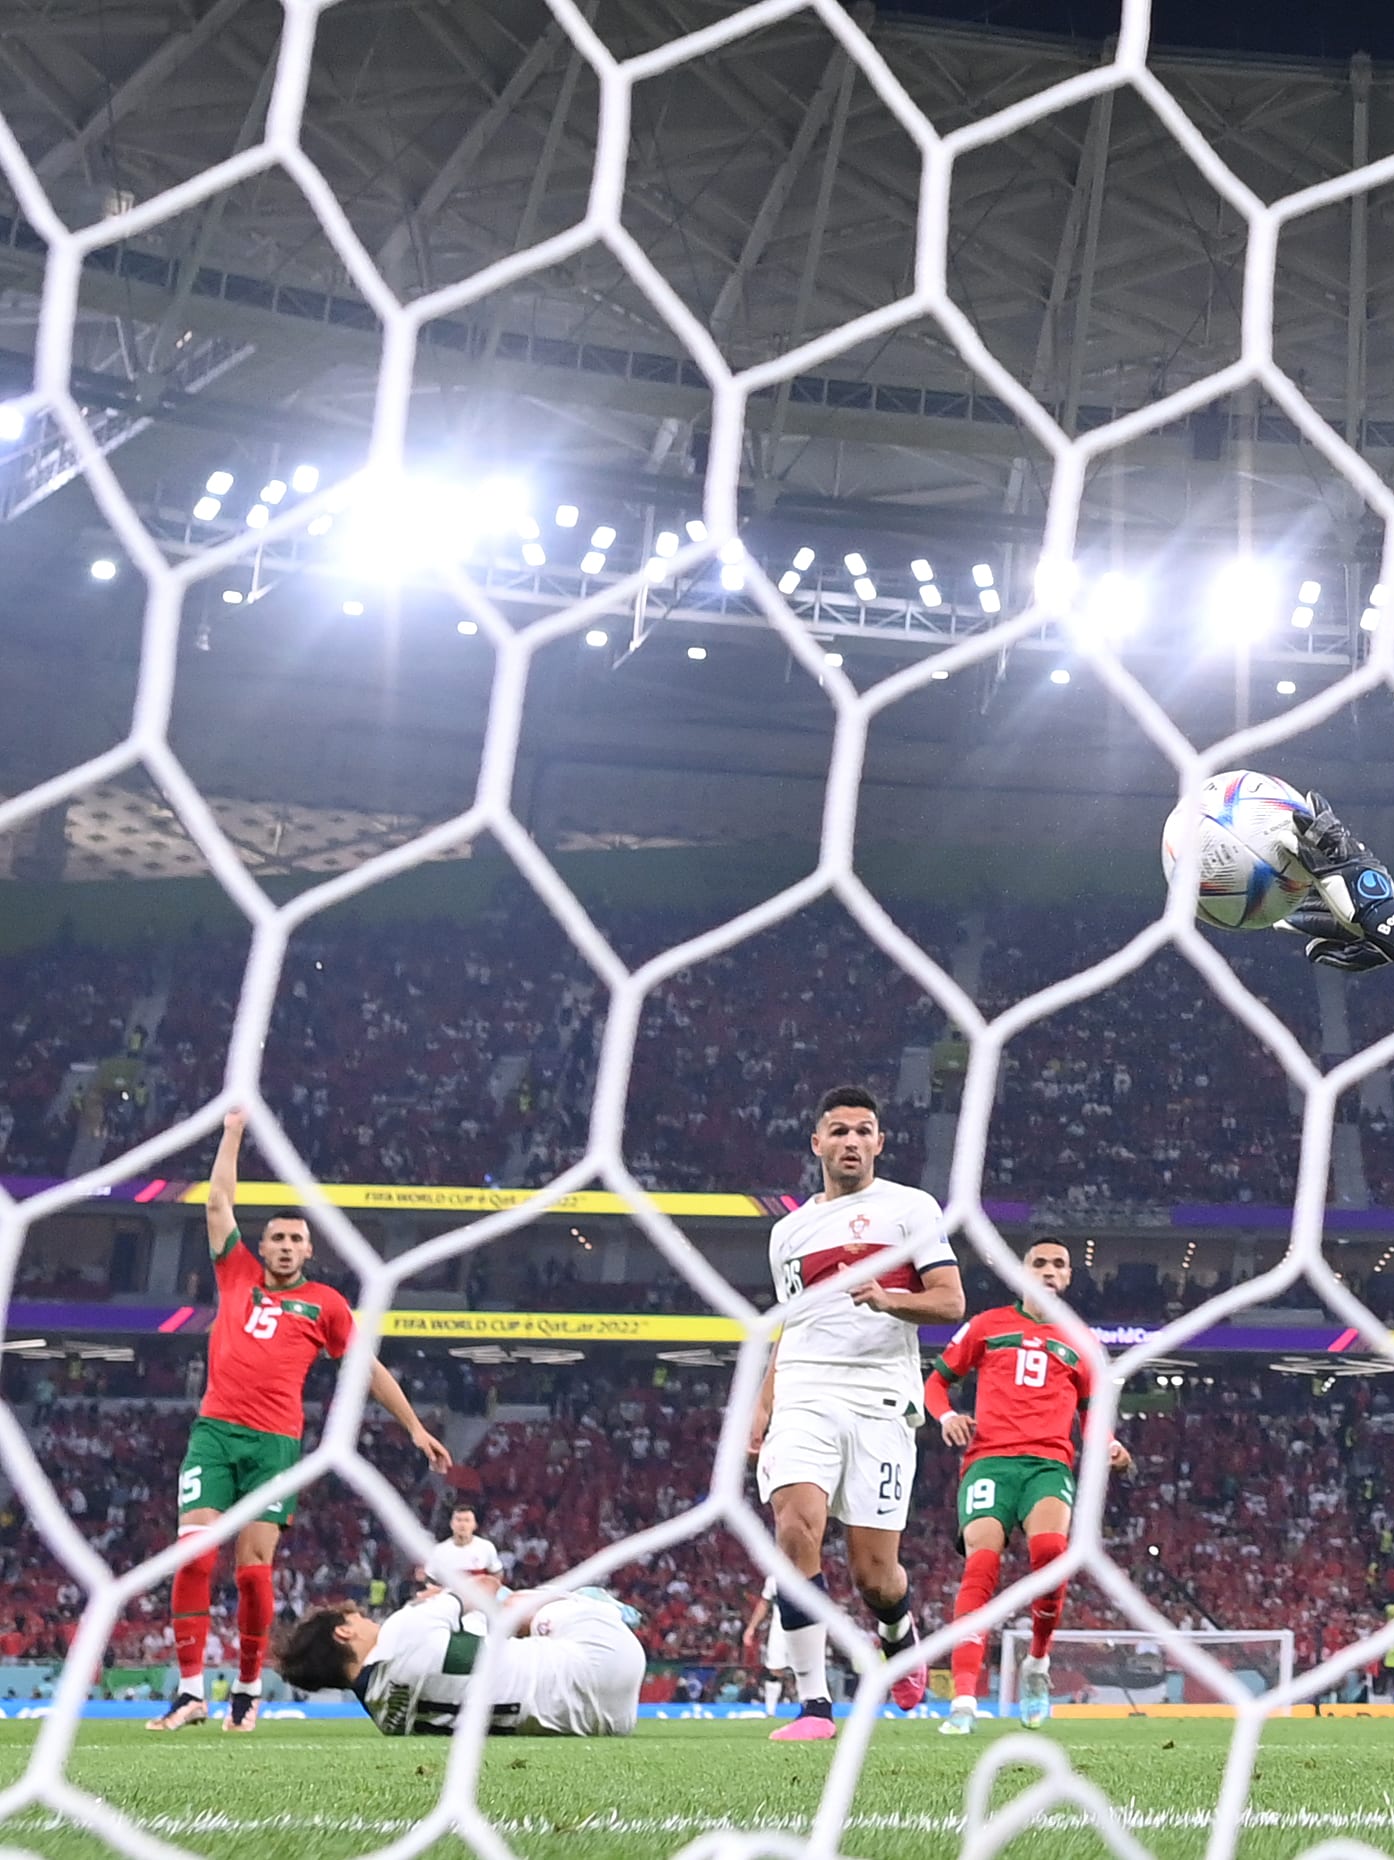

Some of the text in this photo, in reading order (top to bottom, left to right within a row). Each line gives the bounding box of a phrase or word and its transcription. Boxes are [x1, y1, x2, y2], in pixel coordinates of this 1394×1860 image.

[243, 1305, 283, 1340] 15
[393, 1317, 426, 1330] FIFA
[430, 1318, 487, 1331] WORLD
[490, 1320, 520, 1332] CUP
[1014, 1348, 1049, 1388] 19
[879, 1462, 902, 1501] 26
[965, 1478, 996, 1515] 19
